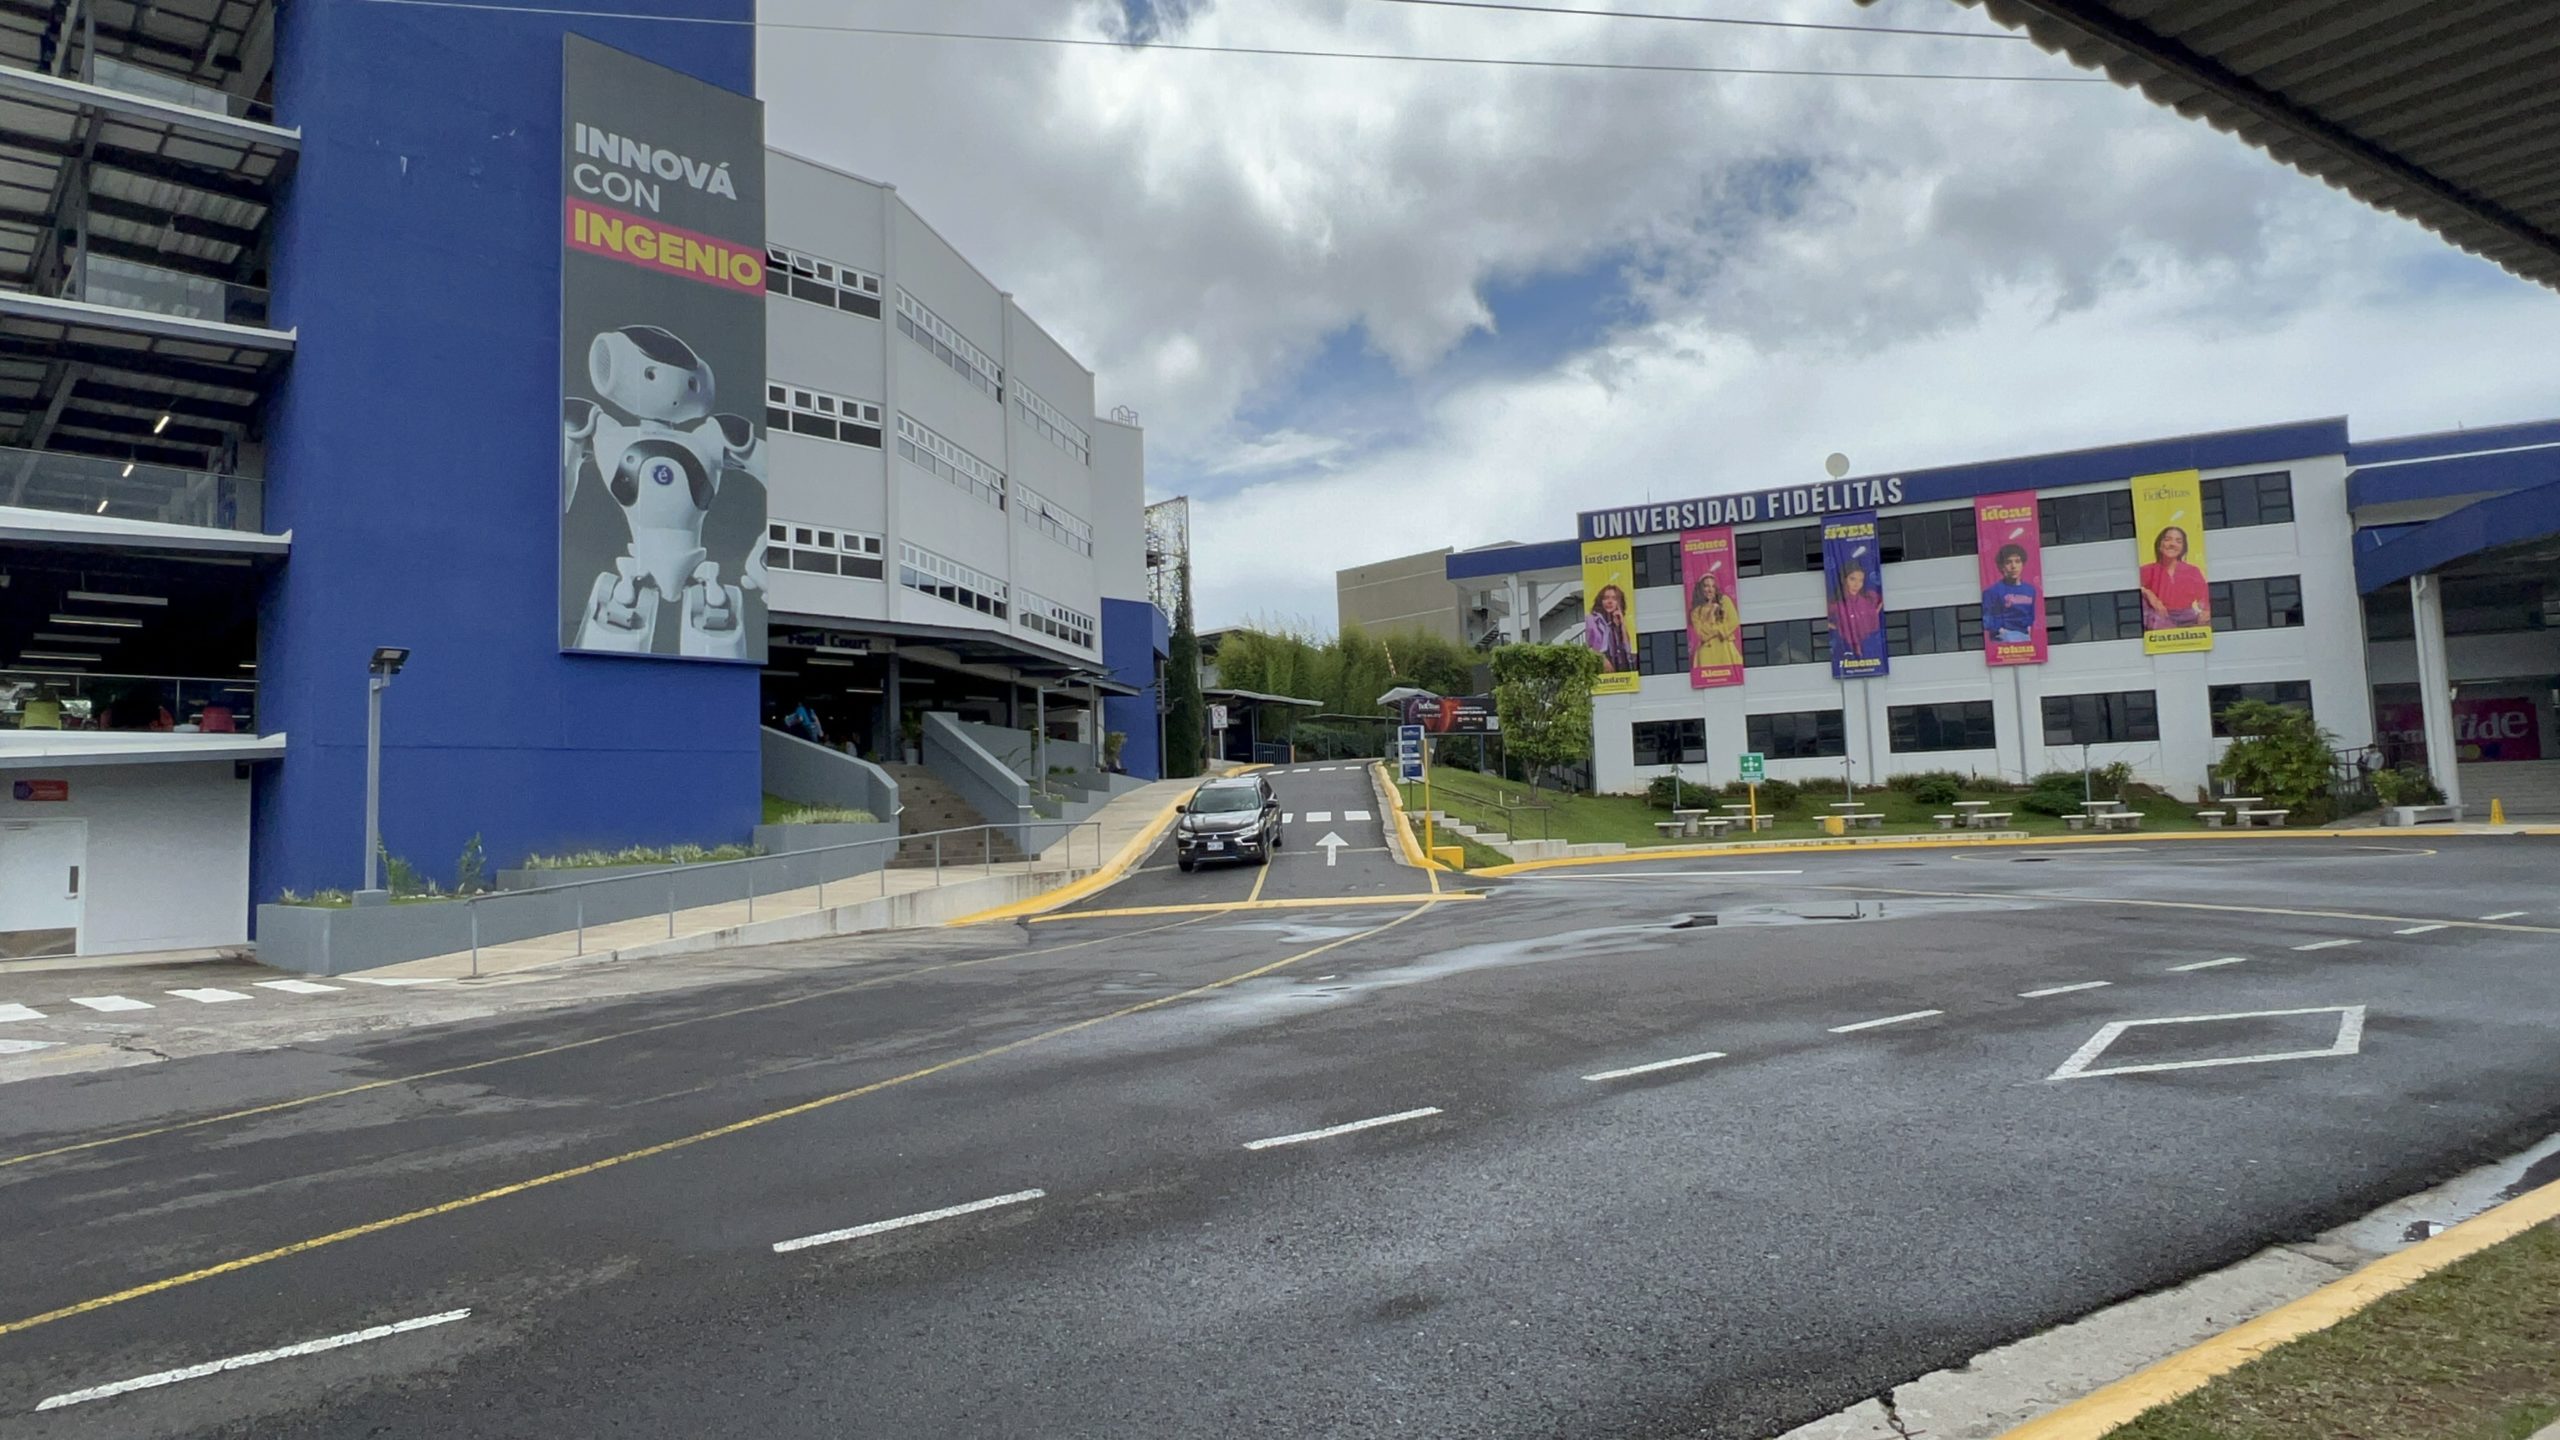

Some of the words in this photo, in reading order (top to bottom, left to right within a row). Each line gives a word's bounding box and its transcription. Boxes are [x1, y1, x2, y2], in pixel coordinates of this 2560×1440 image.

[573, 163, 660, 213] CON
[575, 122, 738, 201] INNOVÁ
[574, 209, 762, 287] INGENIO
[1592, 496, 1756, 539] UNIVERSIDAD
[1767, 477, 1902, 519] FIDÉLITAS
[1584, 551, 1629, 565] ingenio
